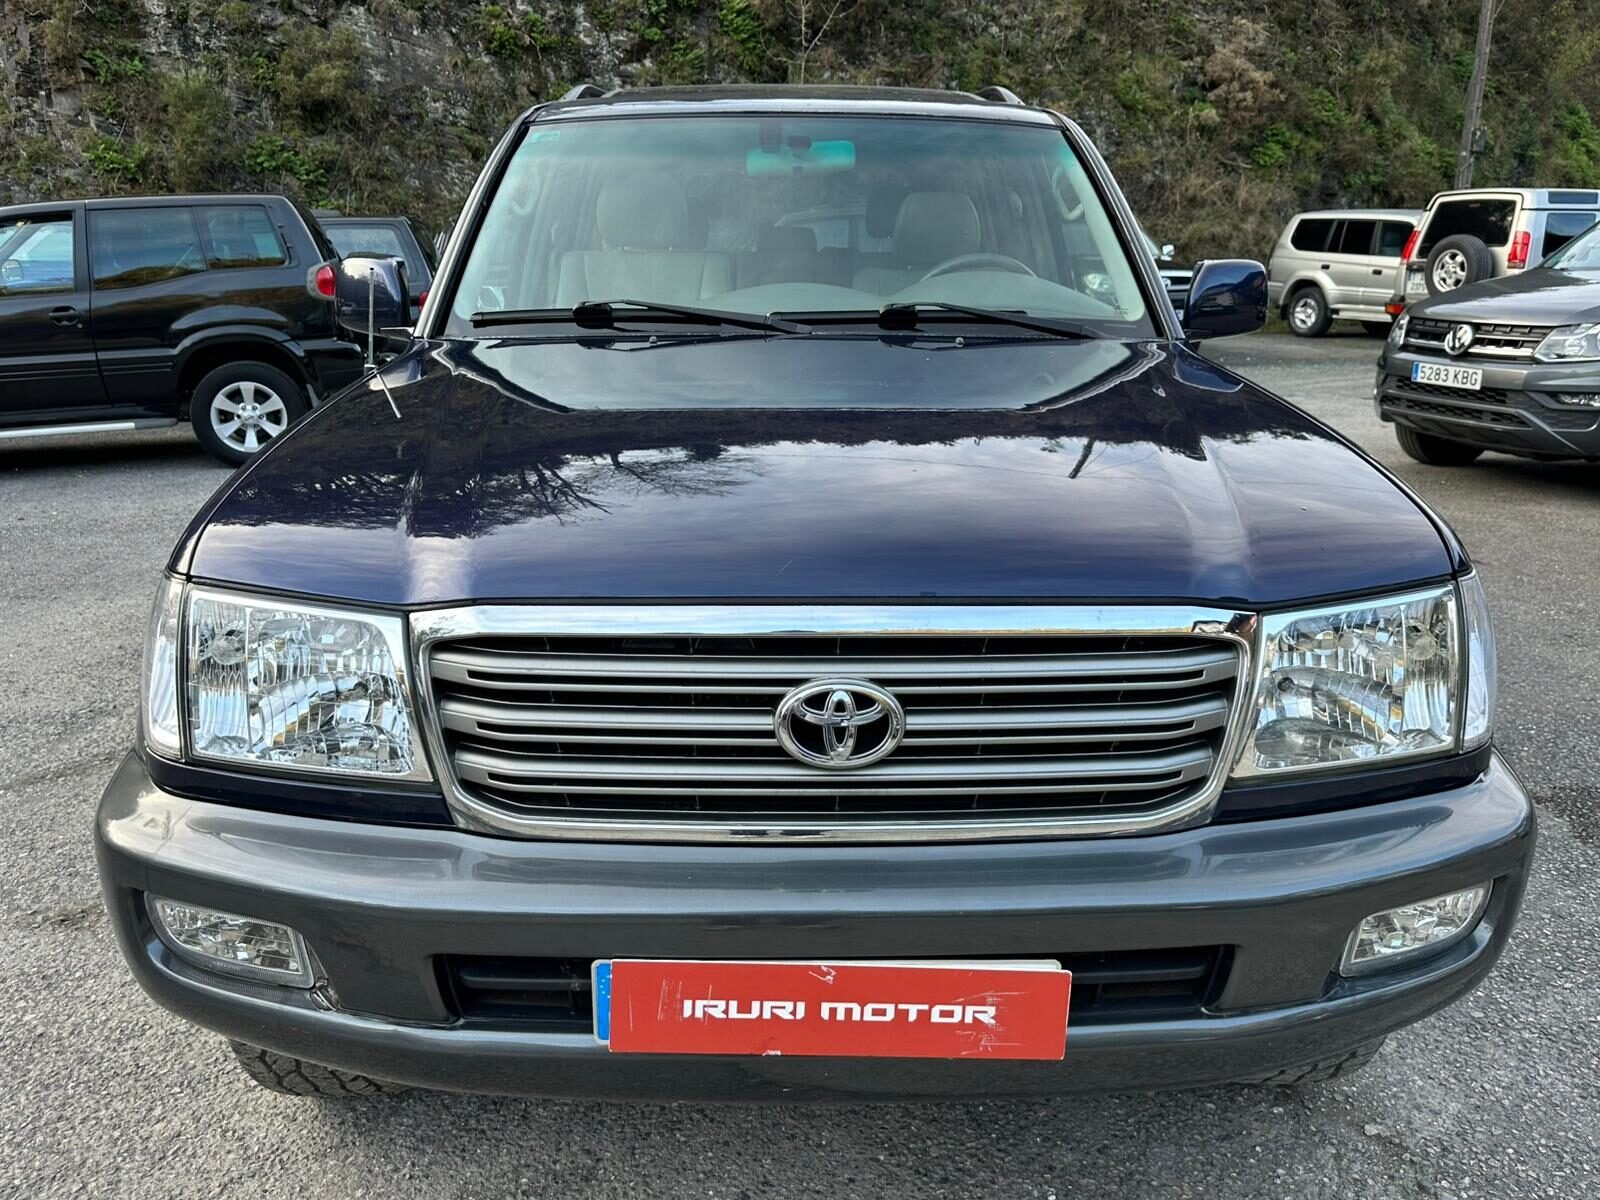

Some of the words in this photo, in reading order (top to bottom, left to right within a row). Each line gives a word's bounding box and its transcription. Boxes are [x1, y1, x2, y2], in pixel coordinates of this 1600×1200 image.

[1420, 365, 1449, 382] 5283
[1453, 369, 1478, 386] KBG
[683, 999, 805, 1020] IRURI
[820, 1001, 996, 1024] MOTOR
